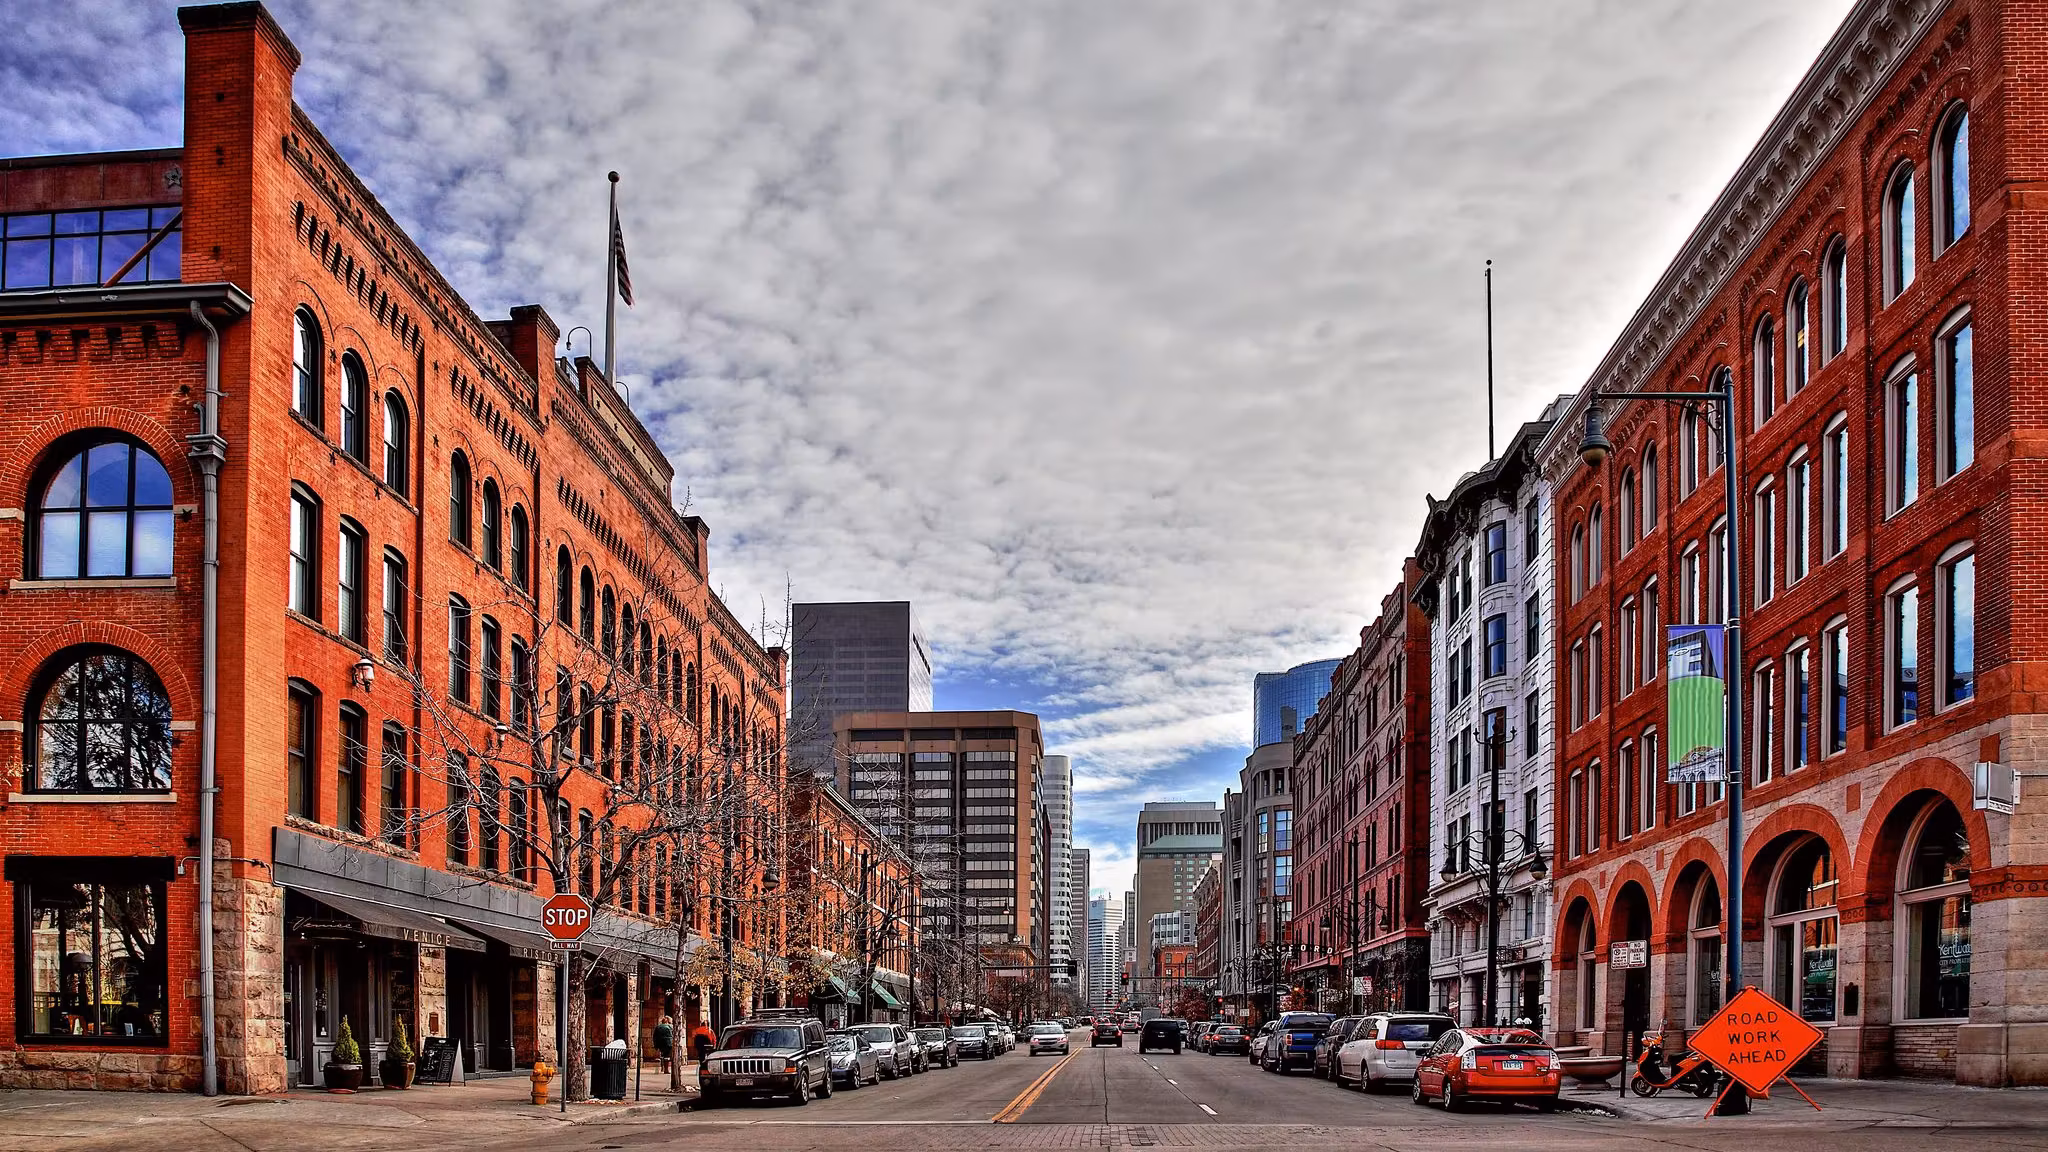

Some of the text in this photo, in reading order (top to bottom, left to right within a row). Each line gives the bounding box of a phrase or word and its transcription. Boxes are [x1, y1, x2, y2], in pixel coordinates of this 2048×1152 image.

[545, 908, 588, 926] STOP
[403, 928, 451, 946] VENICE
[1727, 1011, 1778, 1025] ROAD
[1728, 1030, 1781, 1044] WORK
[1727, 1050, 1786, 1064] AHEAD
